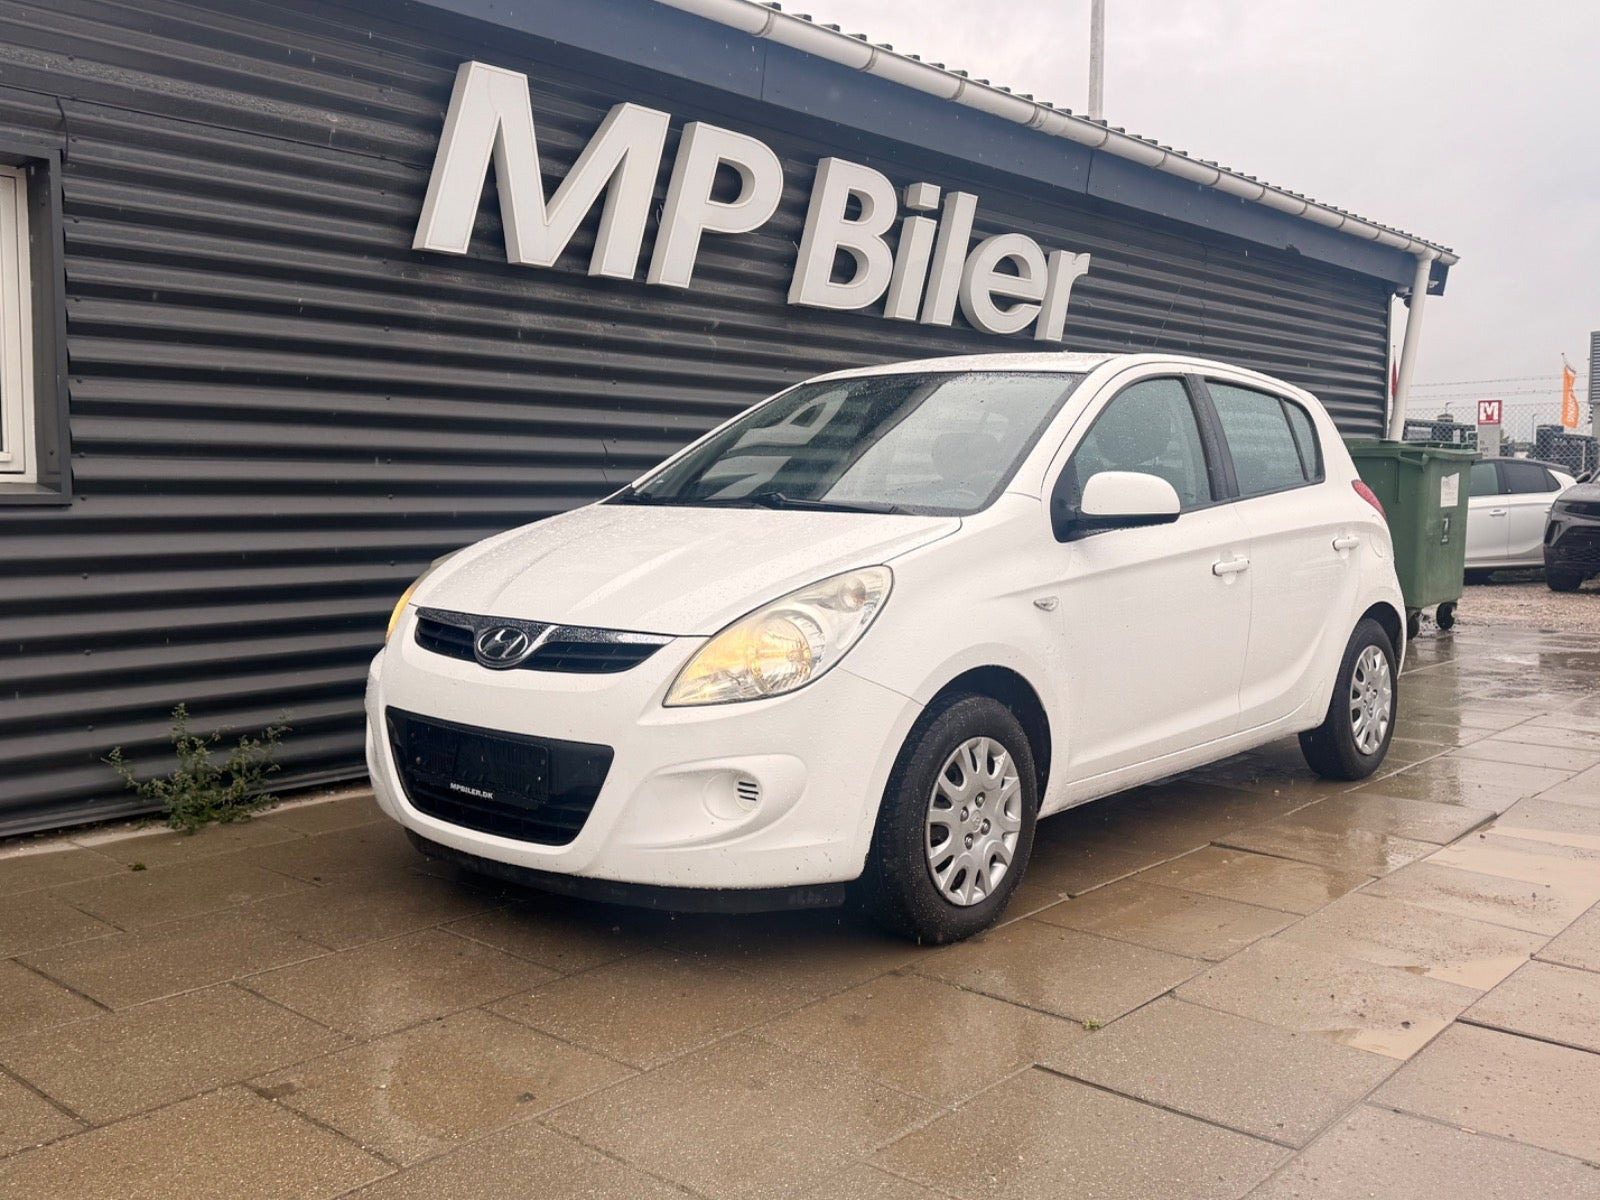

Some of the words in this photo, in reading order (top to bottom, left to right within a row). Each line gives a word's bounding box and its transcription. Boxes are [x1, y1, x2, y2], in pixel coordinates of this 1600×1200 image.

[412, 61, 784, 288] MP
[788, 157, 1091, 342] Biler
[450, 782, 493, 799] MPBILER.DK
